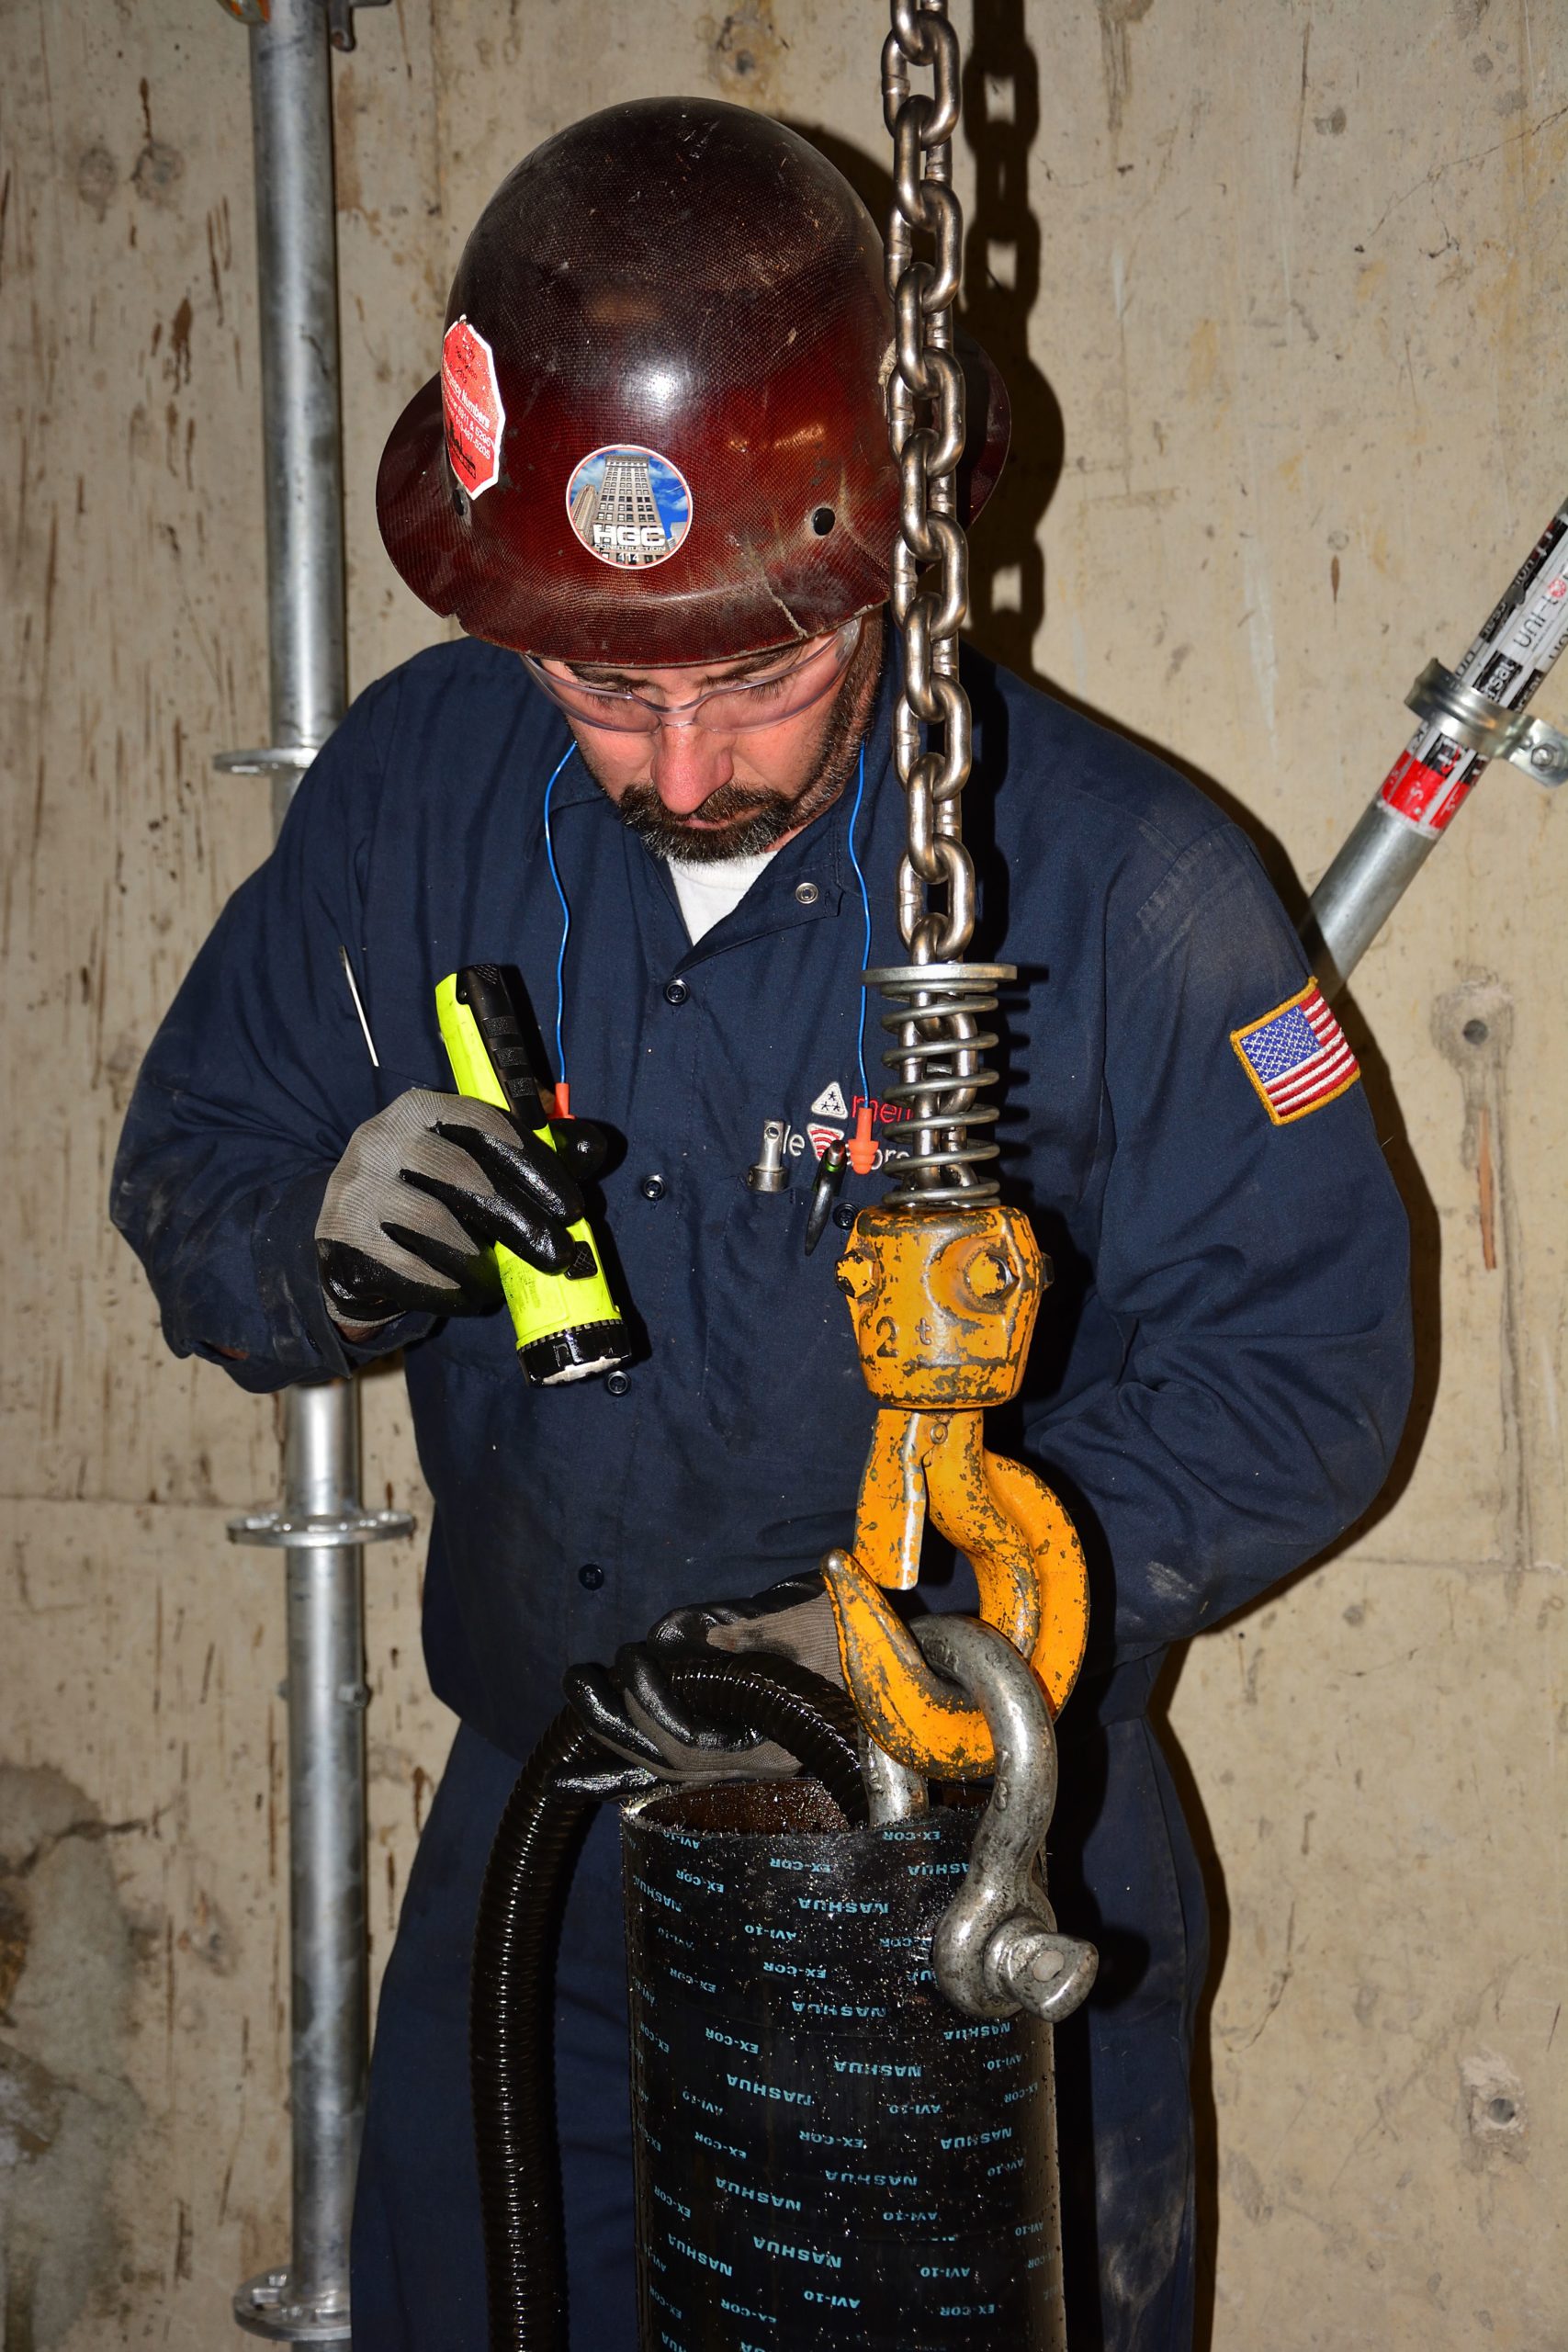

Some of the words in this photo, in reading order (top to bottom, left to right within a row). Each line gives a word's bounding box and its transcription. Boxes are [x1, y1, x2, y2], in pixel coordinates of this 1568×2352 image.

[462, 389, 491, 430] Numbers
[592, 524, 666, 547] HGC
[594, 543, 666, 552] CONSTRUCTION
[617, 553, 640, 563] 114
[874, 1315, 899, 1358] 2
[914, 1317, 932, 1345] t
[770, 1858, 831, 1873] EX-COR
[908, 1861, 969, 1876] ASHUA
[675, 1869, 725, 1894] EX-COR
[797, 1896, 889, 1915] NASHUA
[744, 1925, 797, 1941] AVI-10
[763, 1962, 828, 1979] EX-COR
[670, 1967, 717, 1994] EX-COR
[792, 2000, 886, 2018] NASHUA
[705, 2027, 760, 2054] EX-COR
[943, 2022, 1011, 2041] NASHUA
[833, 2061, 922, 2077] NASHUA
[987, 2054, 1022, 2071] AVI-10
[726, 2073, 814, 2107] NASHUA
[694, 2131, 748, 2160] EX-COR
[798, 2131, 865, 2148] EX-COR
[940, 2126, 1013, 2150] NASHUA
[825, 2170, 919, 2187] NASHUA
[653, 2186, 692, 2219] EX-COR
[716, 2176, 802, 2211] NASHUA
[882, 2211, 939, 2222] AVI-10
[668, 2233, 733, 2278] NASHUA
[752, 2234, 842, 2269] NASHUA
[919, 2266, 970, 2278] AVI-10
[803, 2289, 861, 2309] AVI-10
[940, 2303, 997, 2317] EX-COR
